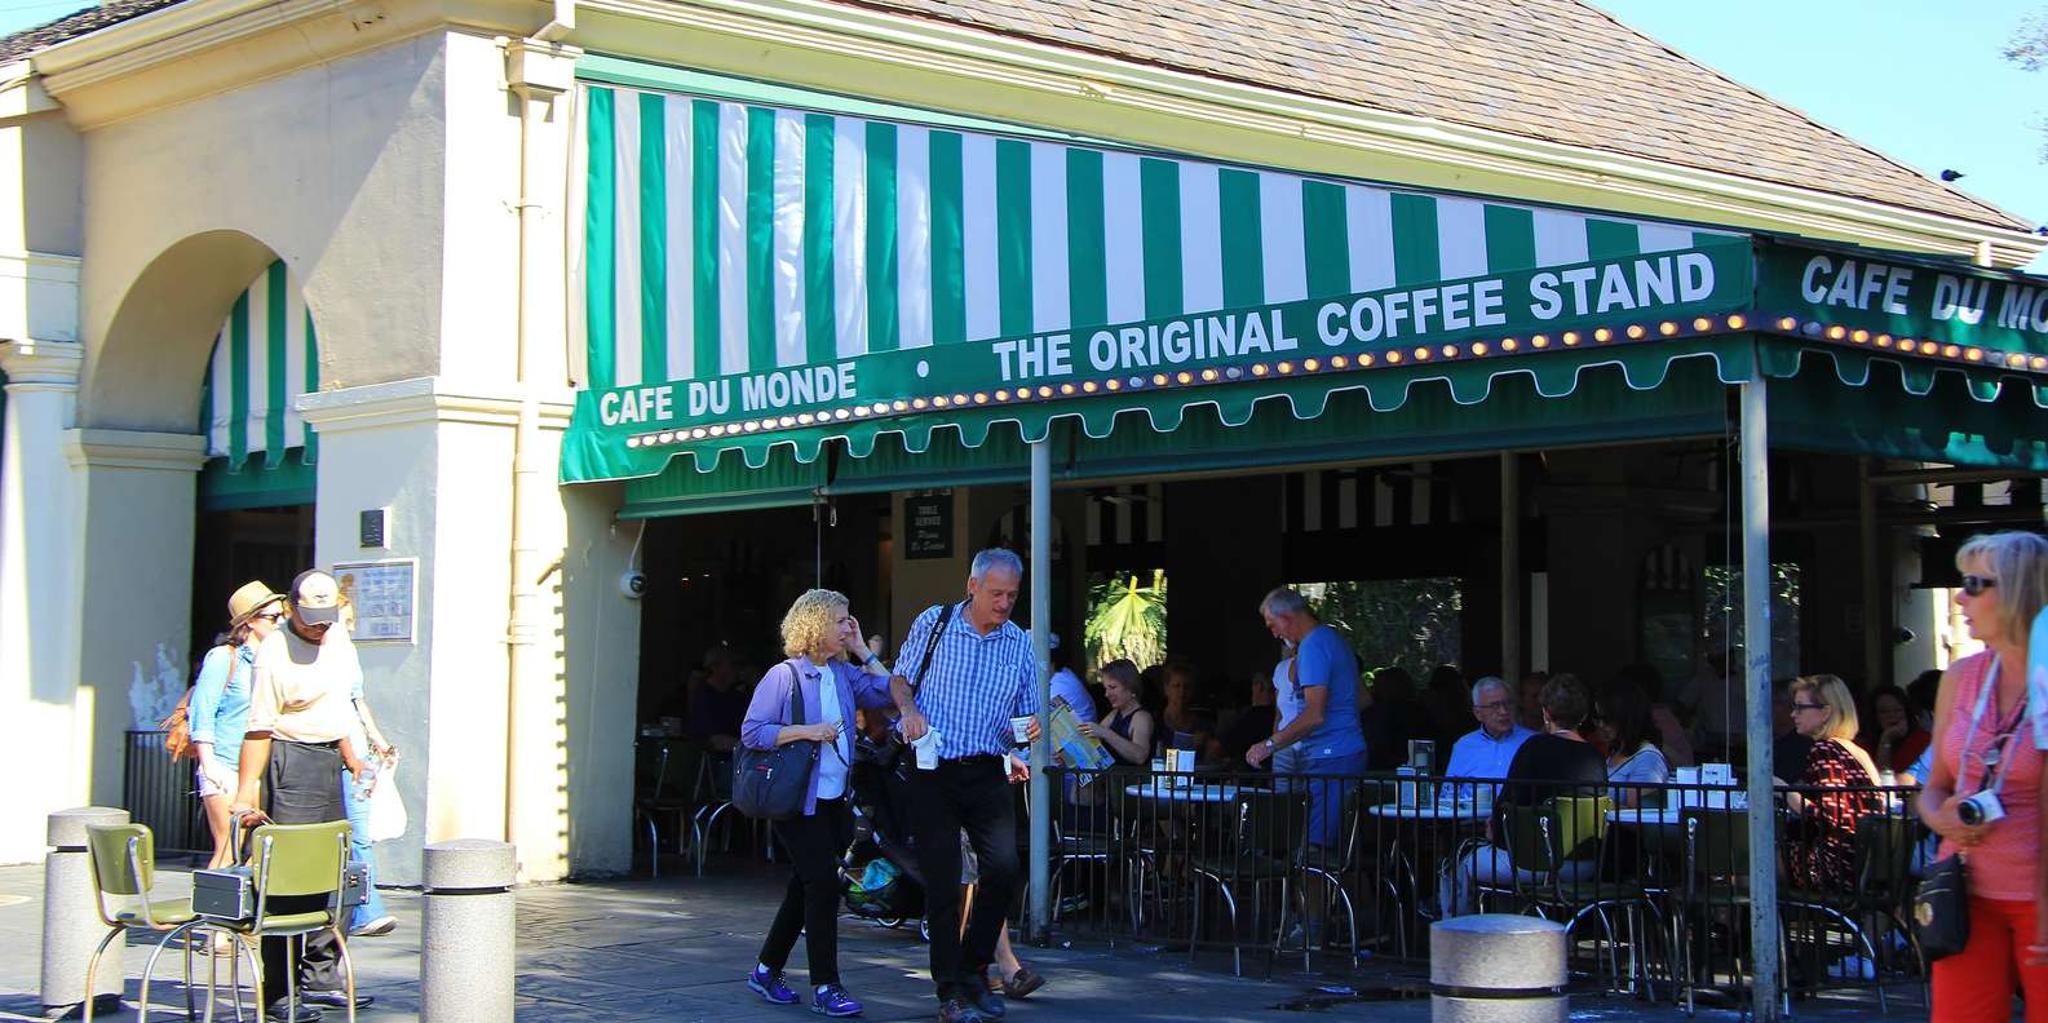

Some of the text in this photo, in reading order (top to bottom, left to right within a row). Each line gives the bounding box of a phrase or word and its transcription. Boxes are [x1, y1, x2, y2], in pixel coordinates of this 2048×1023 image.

[601, 253, 1715, 426] CAFE DU MONDE THE ORIGINAL COFFEE STAND
[1801, 255, 1913, 315] CAFE
[1931, 274, 1990, 325] DU
